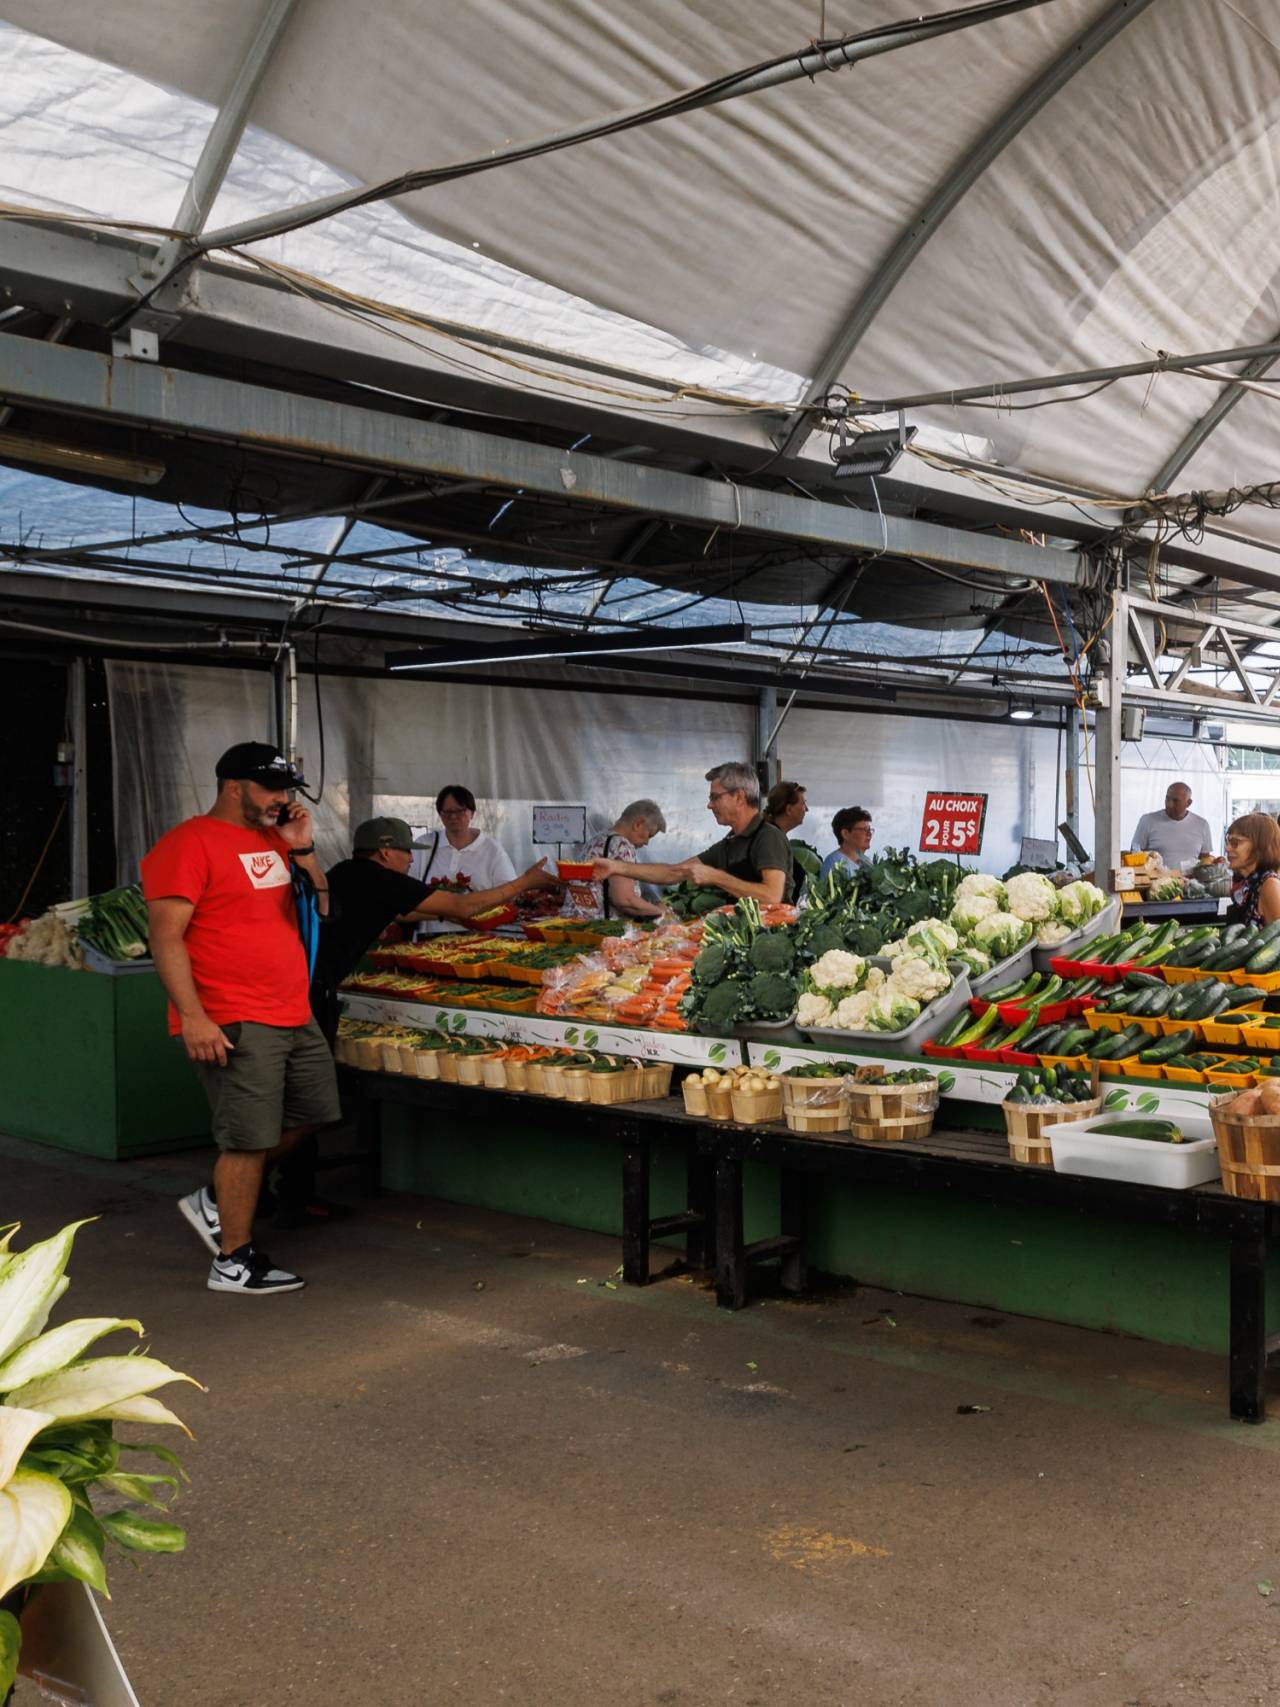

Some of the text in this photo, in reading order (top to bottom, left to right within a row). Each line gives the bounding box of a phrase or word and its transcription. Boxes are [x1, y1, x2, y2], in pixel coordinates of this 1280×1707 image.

[929, 799, 978, 813] AU CHOIX
[925, 819, 940, 846] 2
[942, 820, 950, 846] POUR
[252, 855, 271, 868] NIKE
